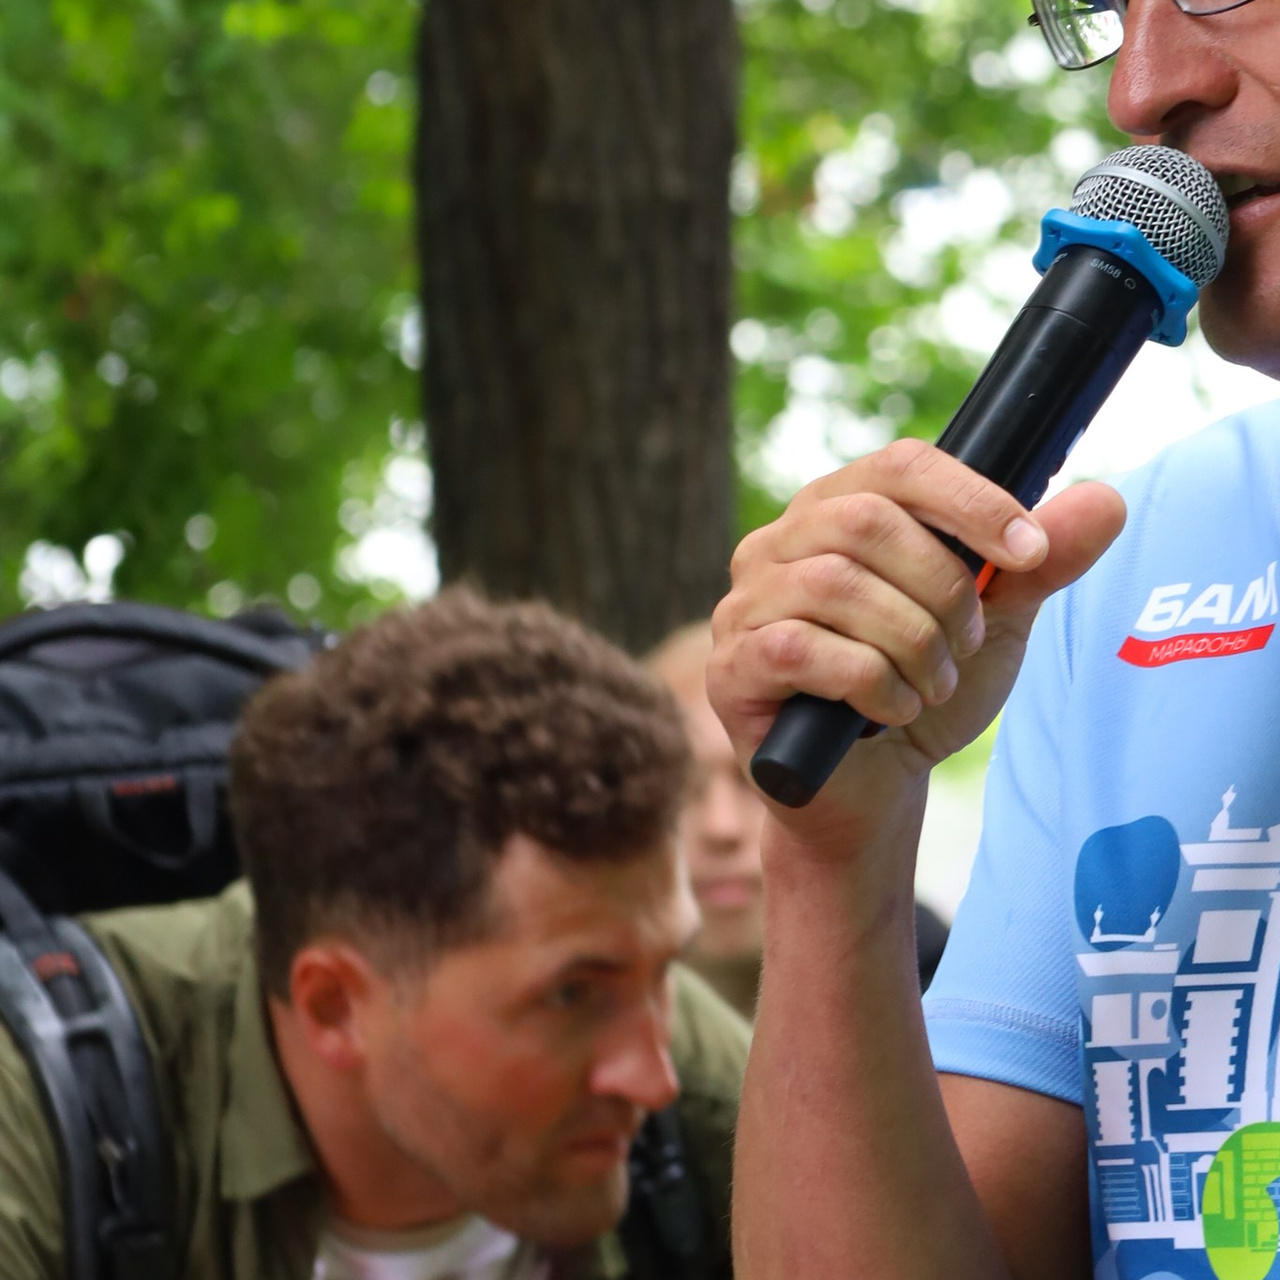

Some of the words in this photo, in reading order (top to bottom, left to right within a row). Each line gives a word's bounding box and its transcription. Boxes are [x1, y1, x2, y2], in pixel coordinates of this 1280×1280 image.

[1089, 258, 1122, 279] SM58
[1134, 560, 1279, 633] БАМ
[1148, 633, 1253, 663] МАРАФОНЫ
